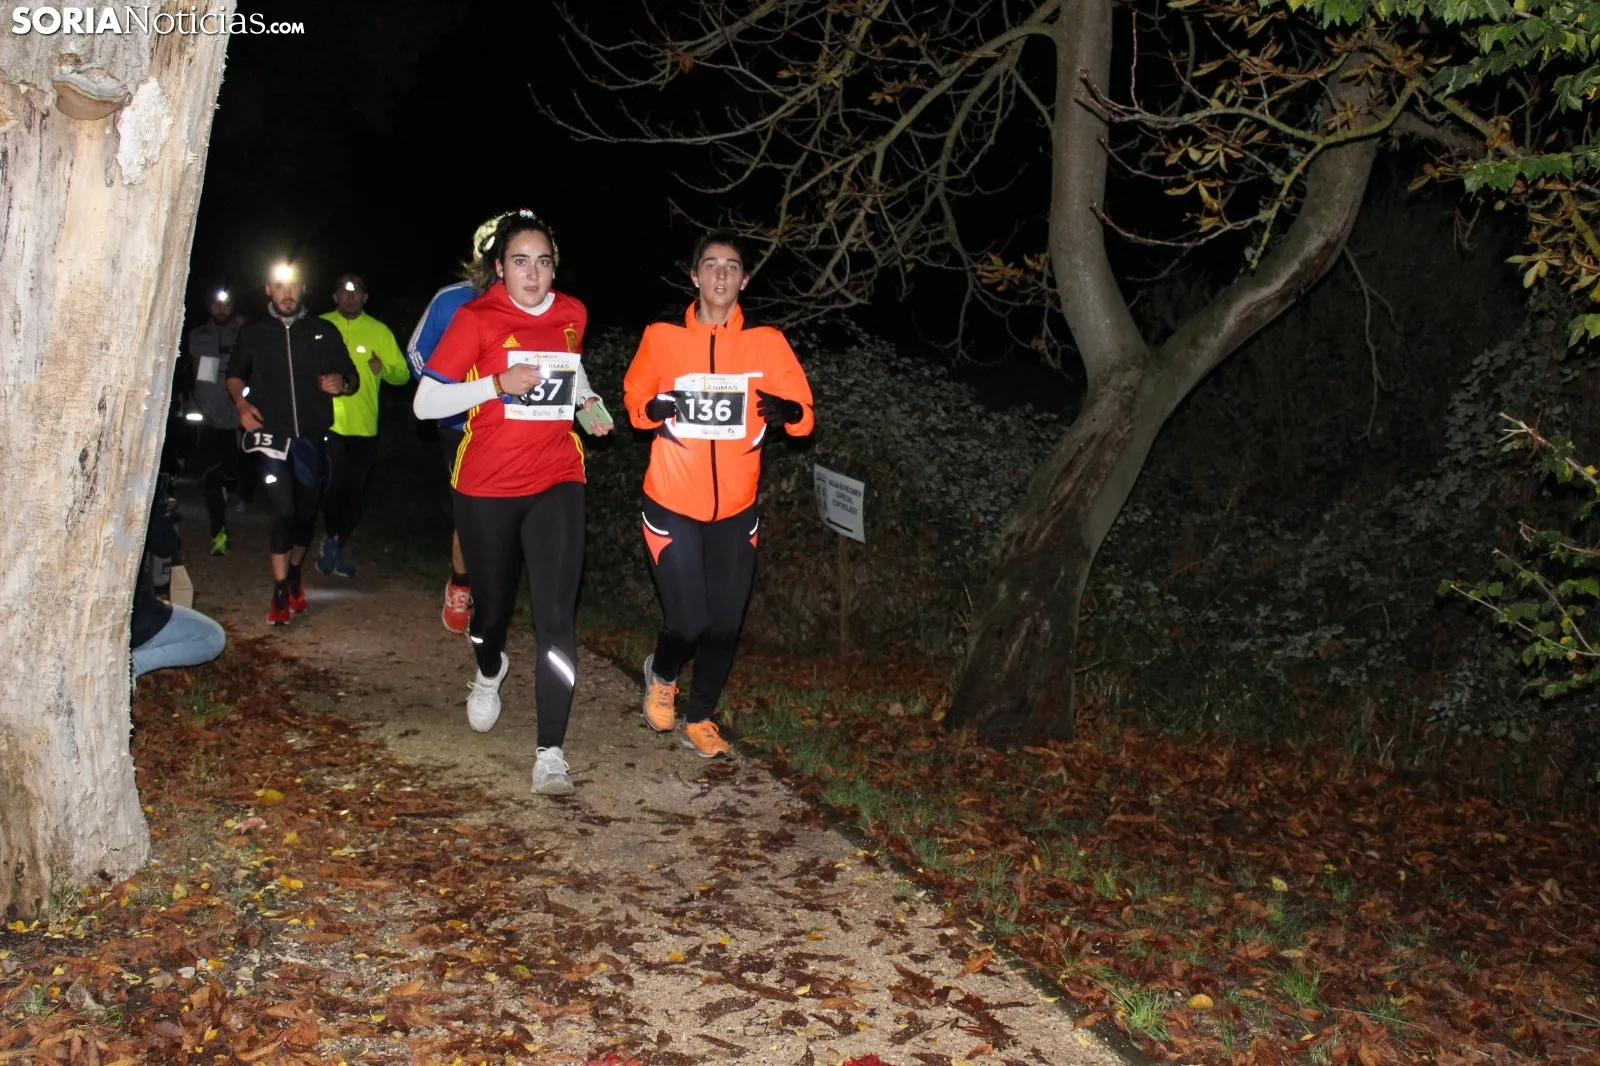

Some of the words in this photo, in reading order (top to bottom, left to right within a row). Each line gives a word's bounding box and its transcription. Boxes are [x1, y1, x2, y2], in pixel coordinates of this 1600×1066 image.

[521, 378, 564, 402] 37
[685, 398, 732, 422] 136
[253, 432, 274, 447] 13
